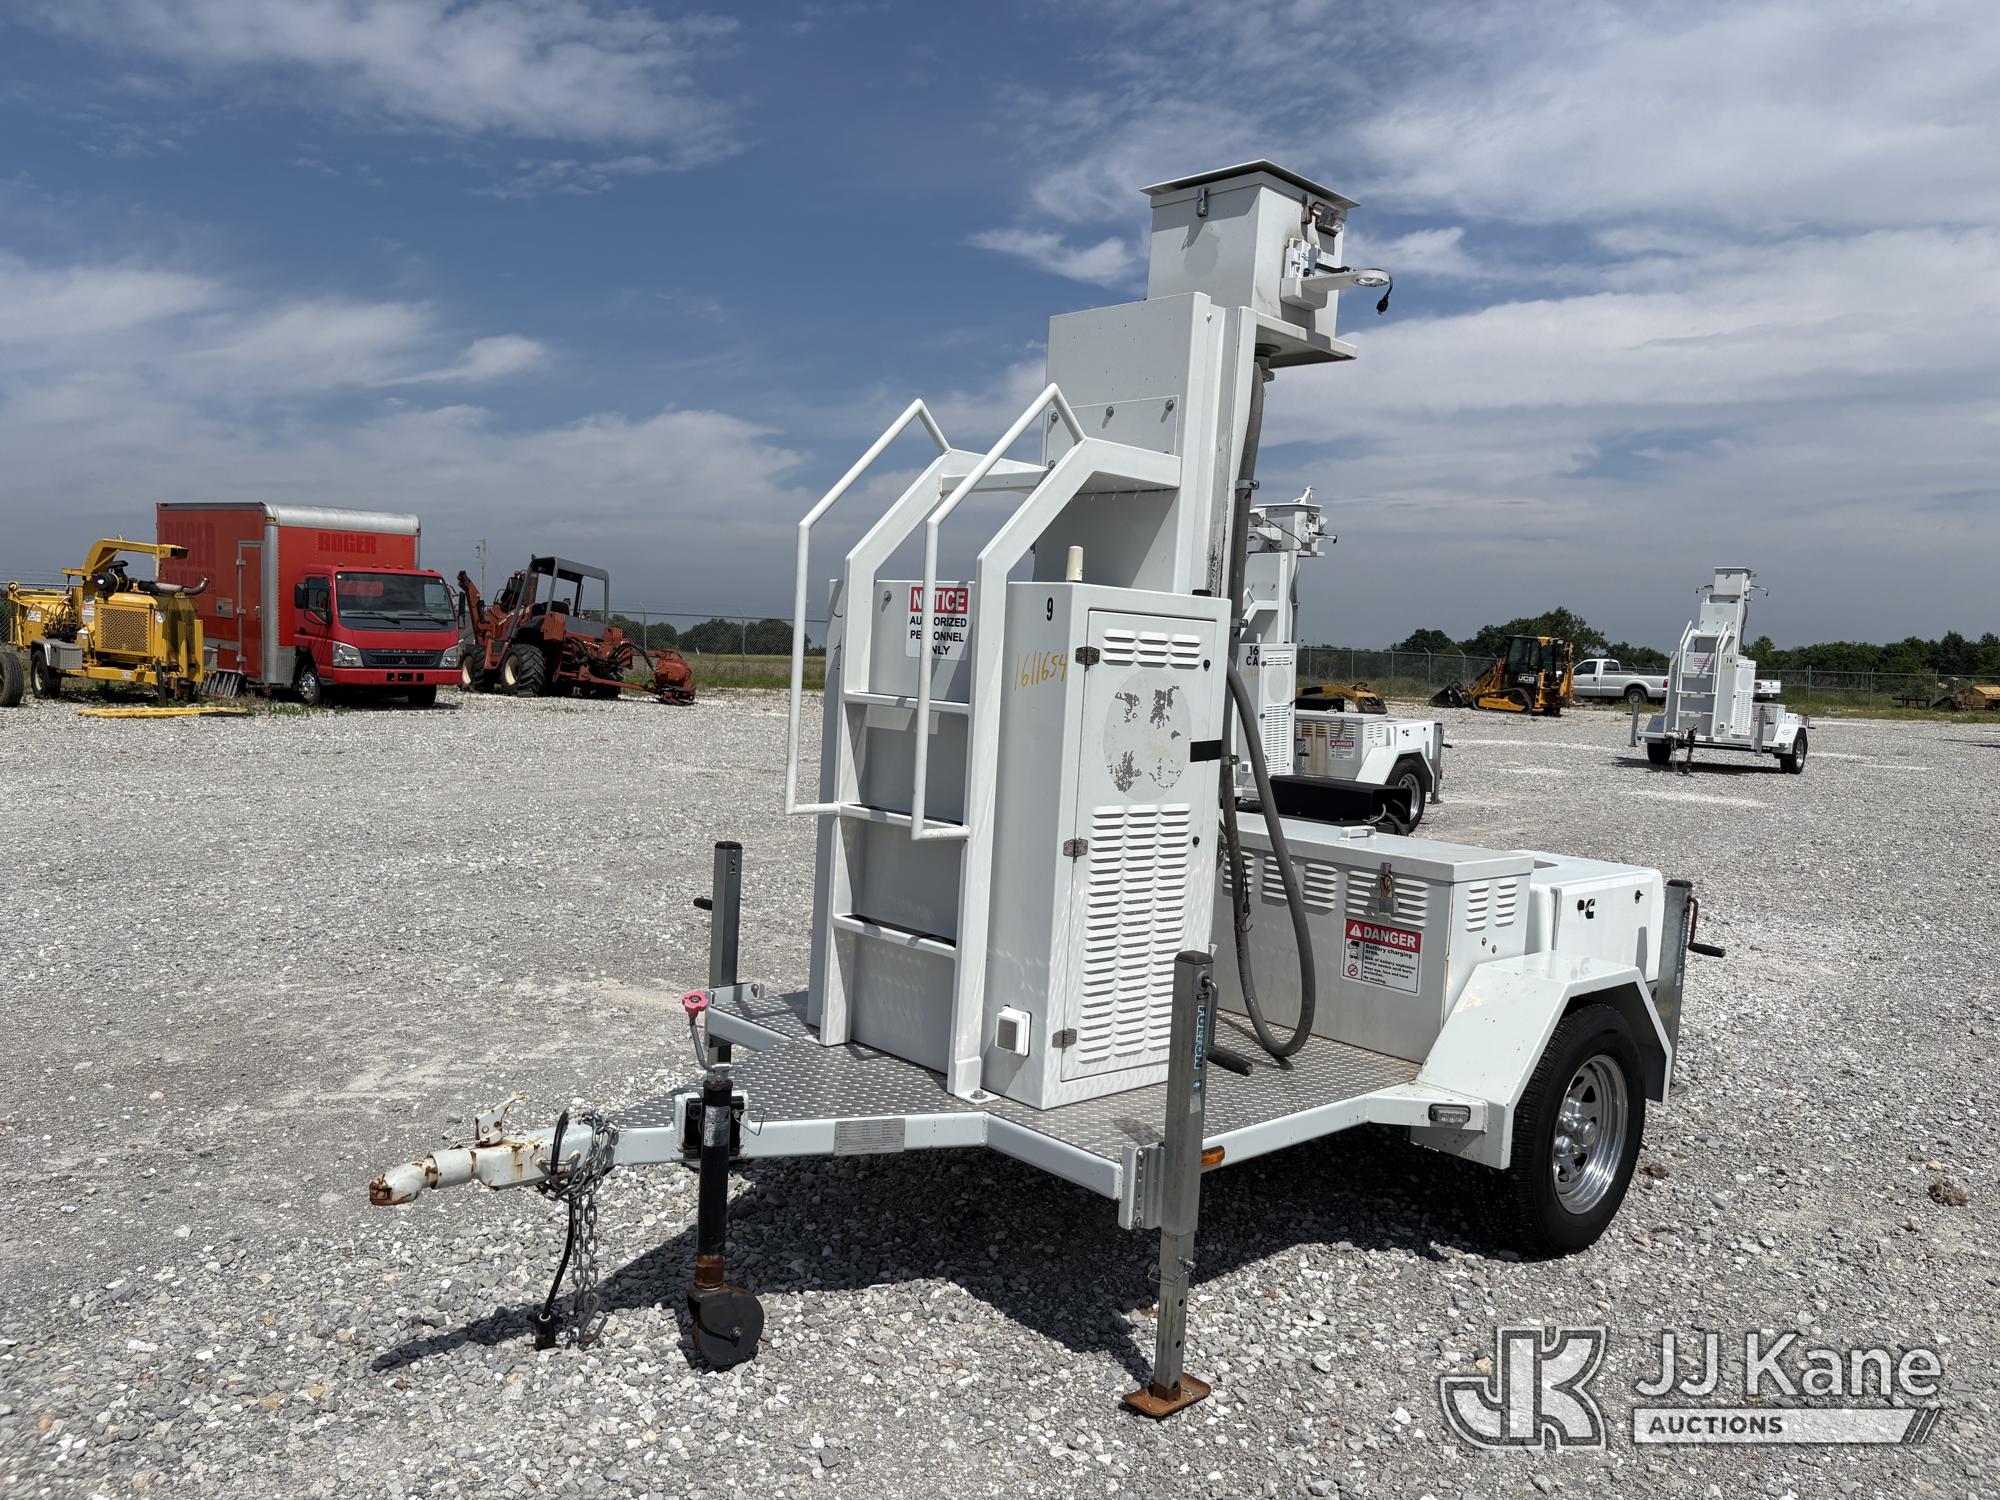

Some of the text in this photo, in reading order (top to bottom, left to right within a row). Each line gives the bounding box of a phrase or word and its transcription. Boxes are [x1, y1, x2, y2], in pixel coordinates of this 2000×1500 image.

[912, 590, 965, 611] NTICE
[1046, 597, 1054, 622] 9
[909, 617, 967, 628] AUORIZED
[910, 630, 965, 642] PEONNEL
[927, 645, 950, 656] NLY
[1249, 645, 1259, 656] 16
[1246, 656, 1259, 666] CA
[1014, 651, 1069, 691] 1611654
[1363, 926, 1416, 948] DANGER
[1193, 1005, 1207, 1070] FULTON
